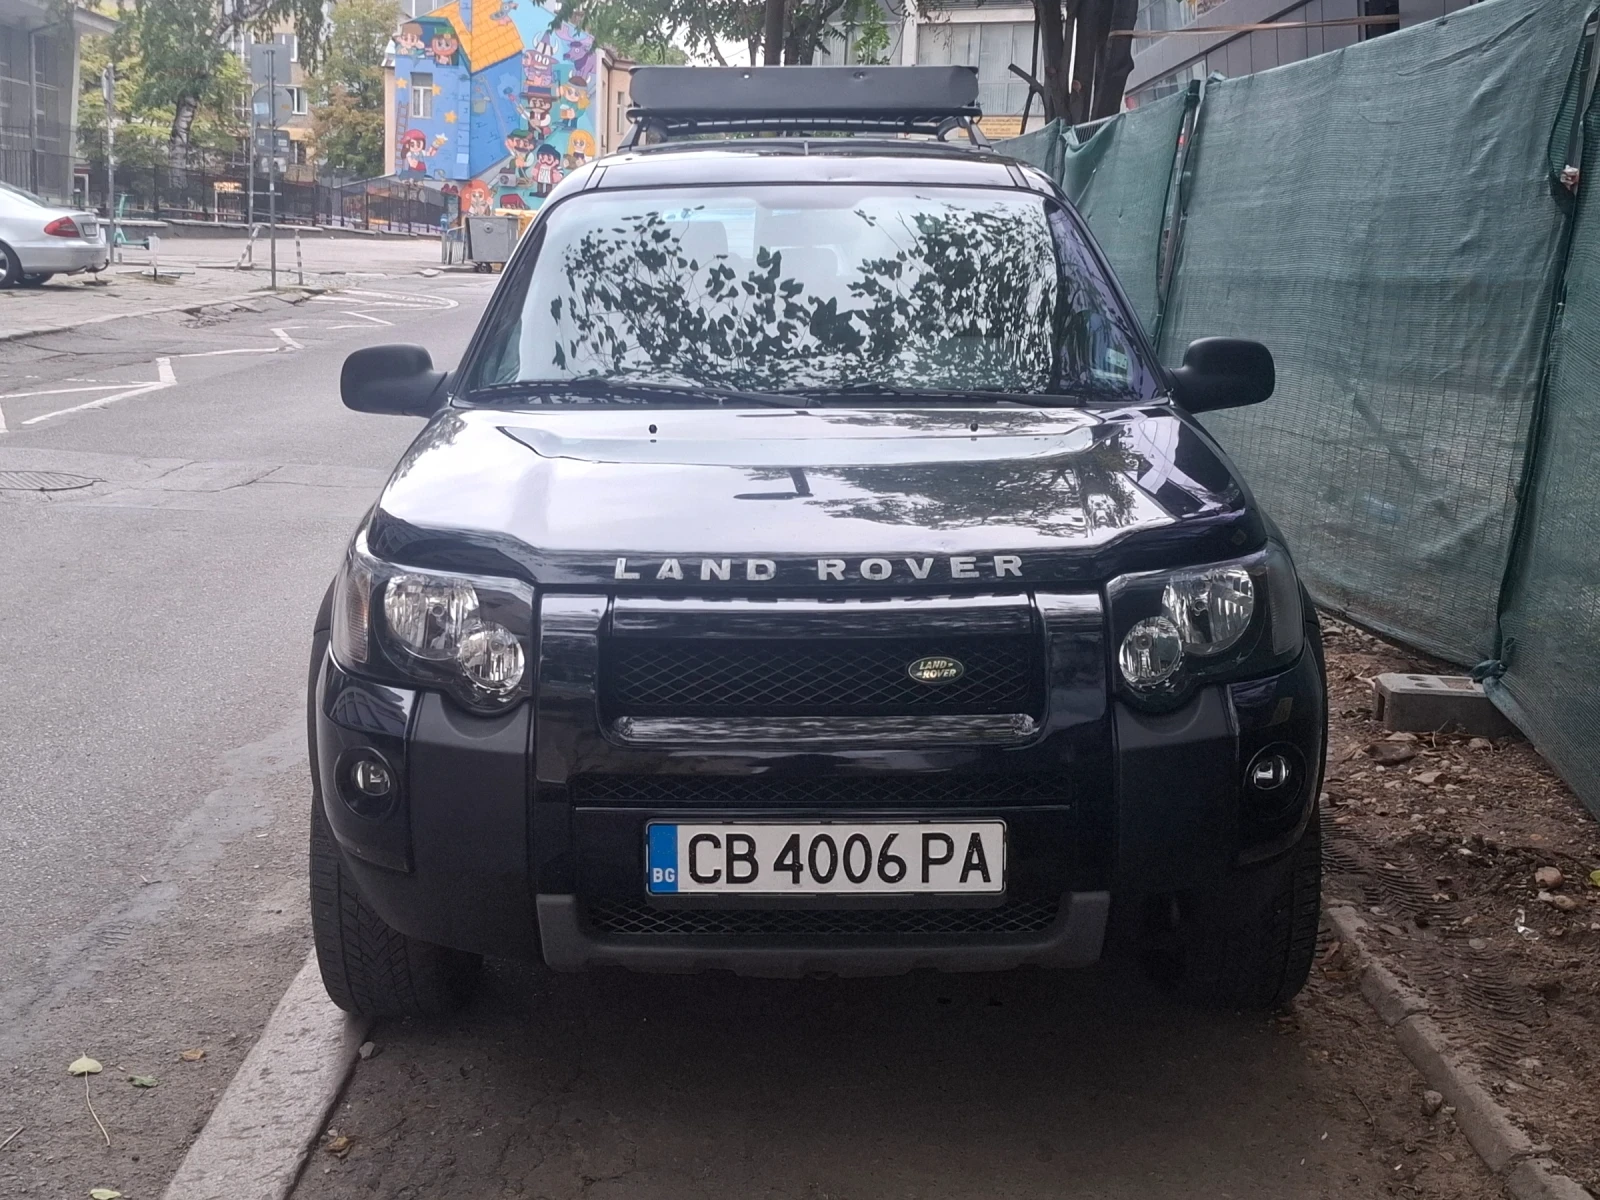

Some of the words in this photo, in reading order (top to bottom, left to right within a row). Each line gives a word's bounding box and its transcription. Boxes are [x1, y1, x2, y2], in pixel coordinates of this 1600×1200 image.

[614, 557, 777, 581] LAND
[817, 555, 1023, 581] ROVER
[688, 833, 759, 884] CB
[773, 833, 907, 884] 4006
[921, 832, 992, 883] PA
[652, 870, 676, 883] BG
